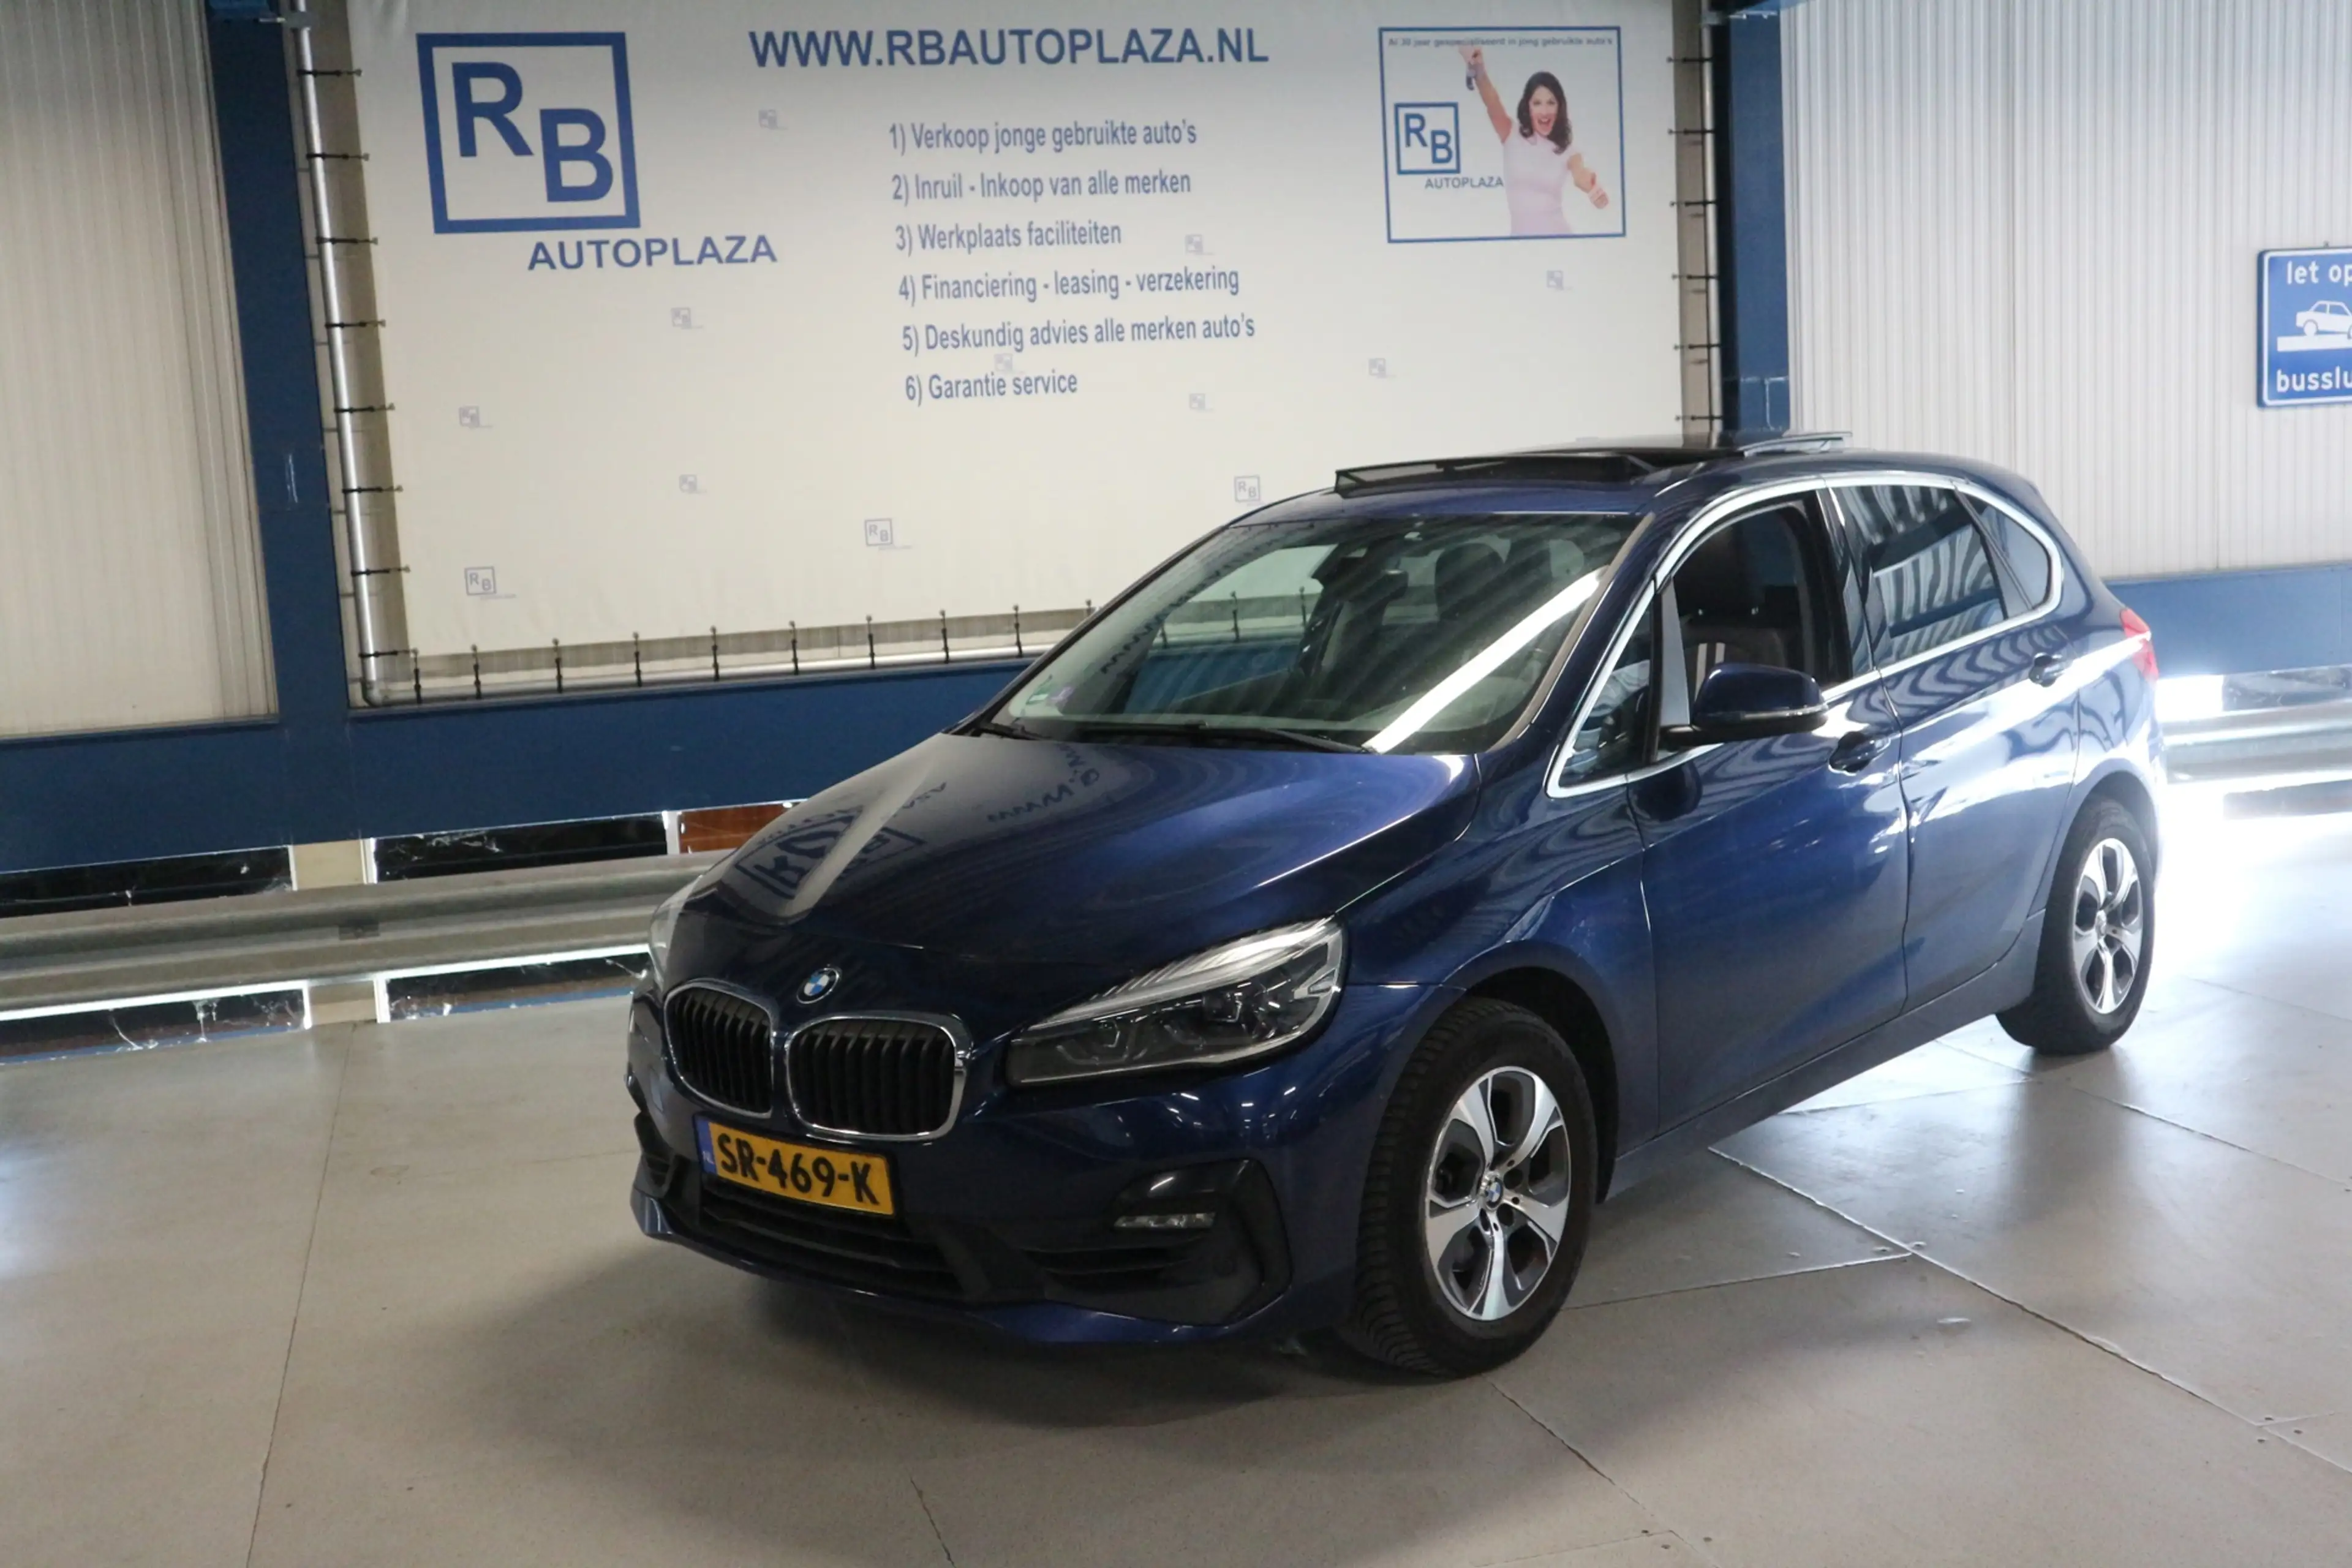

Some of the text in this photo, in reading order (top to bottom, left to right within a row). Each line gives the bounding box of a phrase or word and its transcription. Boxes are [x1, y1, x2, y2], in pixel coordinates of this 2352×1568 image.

[748, 28, 1270, 68] WWW.RBAUTOPLAZA.NL
[452, 62, 614, 203] RB
[889, 119, 1197, 156] 1) Verkoop jonge gebruikte auto's
[1404, 113, 1453, 164] RB
[892, 174, 909, 206] 2)
[915, 173, 963, 200] Inruil
[981, 172, 1044, 203] Inkoop
[1049, 176, 1082, 197] van
[1088, 170, 1119, 196] alle
[1125, 168, 1191, 195] merken
[1425, 176, 1504, 189] AUTOPLAZA
[527, 235, 777, 271] AUTOPLAZA
[895, 219, 1121, 257] 3) Werkplaats faciliteiten
[899, 276, 916, 307] 4)
[922, 272, 1037, 303] Financiering
[1054, 269, 1119, 300] leasing
[1136, 265, 1239, 296] verzekering
[2286, 260, 2319, 285] let
[903, 312, 1256, 357] 5) Deskundig advies alle merken auto's
[905, 369, 1078, 407] 6) Garantie service
[717, 1133, 880, 1206] SR-469-K
